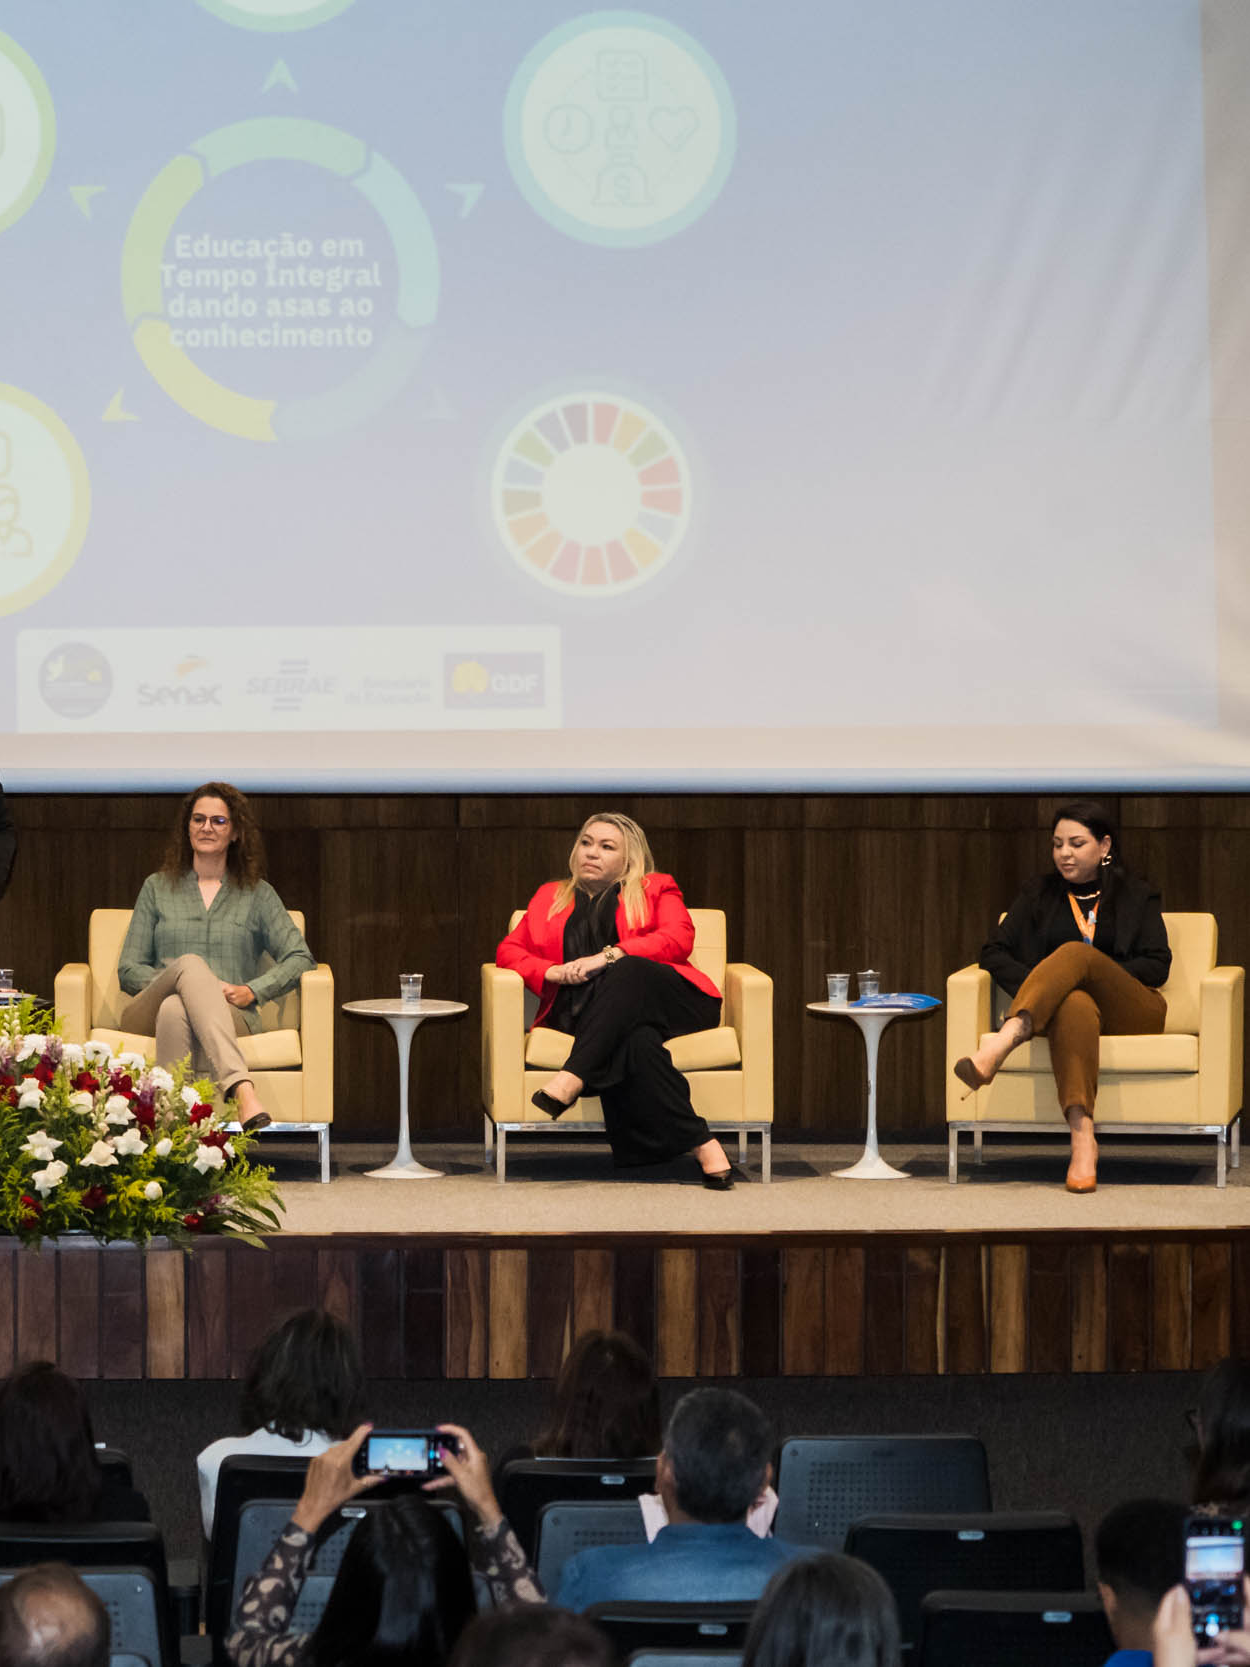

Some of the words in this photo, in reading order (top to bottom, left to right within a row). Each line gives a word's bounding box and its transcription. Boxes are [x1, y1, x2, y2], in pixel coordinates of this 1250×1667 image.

[175, 232, 313, 261] Educação
[321, 238, 364, 257] em
[161, 264, 257, 292] Tempo
[265, 262, 382, 292] Integral
[169, 292, 257, 318] dando
[266, 299, 331, 318] asas
[340, 299, 374, 318] ao
[170, 322, 373, 347] conhecimento
[246, 675, 336, 695] SEBRAE
[491, 673, 540, 694] GDF
